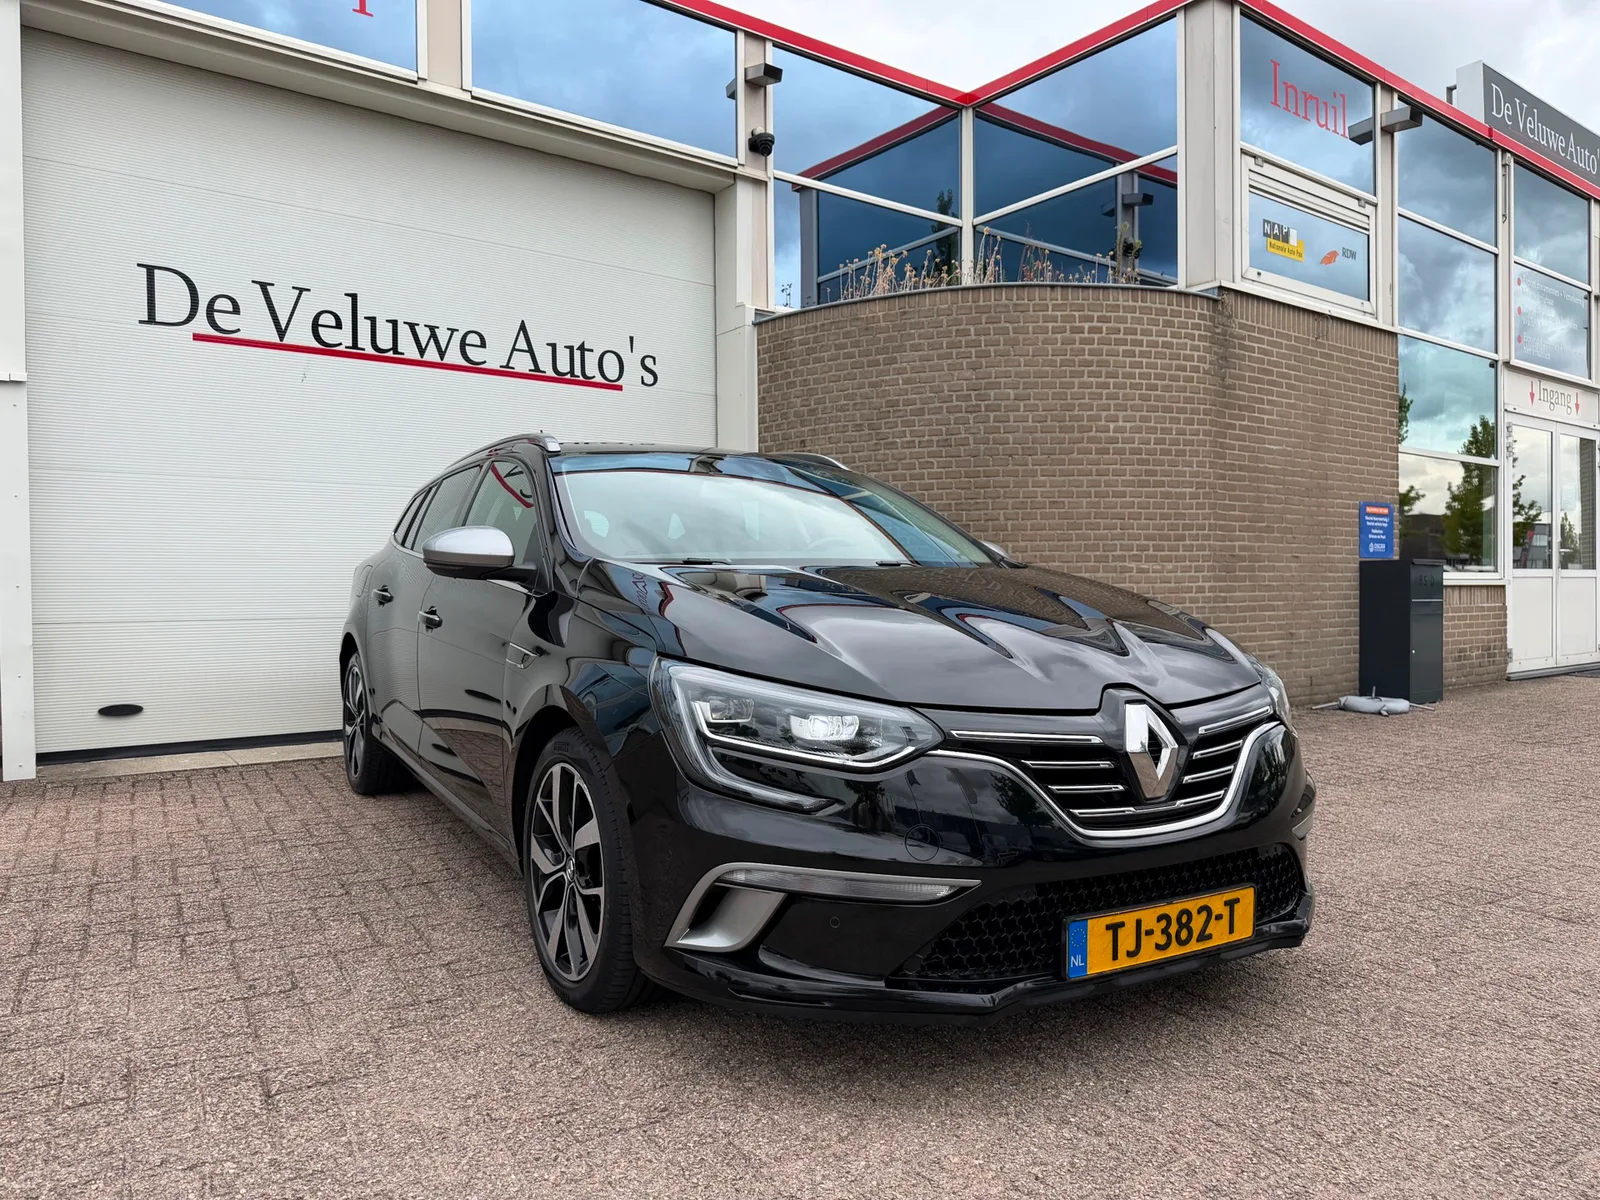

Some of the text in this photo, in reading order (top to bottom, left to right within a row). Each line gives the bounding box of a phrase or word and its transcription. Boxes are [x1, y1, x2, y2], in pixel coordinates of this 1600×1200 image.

[1269, 58, 1349, 139] Inruil
[1491, 83, 1600, 175] De Veluwe Auto'
[1264, 220, 1288, 236] NAP
[1342, 246, 1357, 260] RDW
[136, 262, 659, 387] De Veluwe Auto's
[1538, 379, 1572, 415] Ingang
[1105, 897, 1241, 961] TJ-382-T
[1070, 954, 1085, 967] NL
